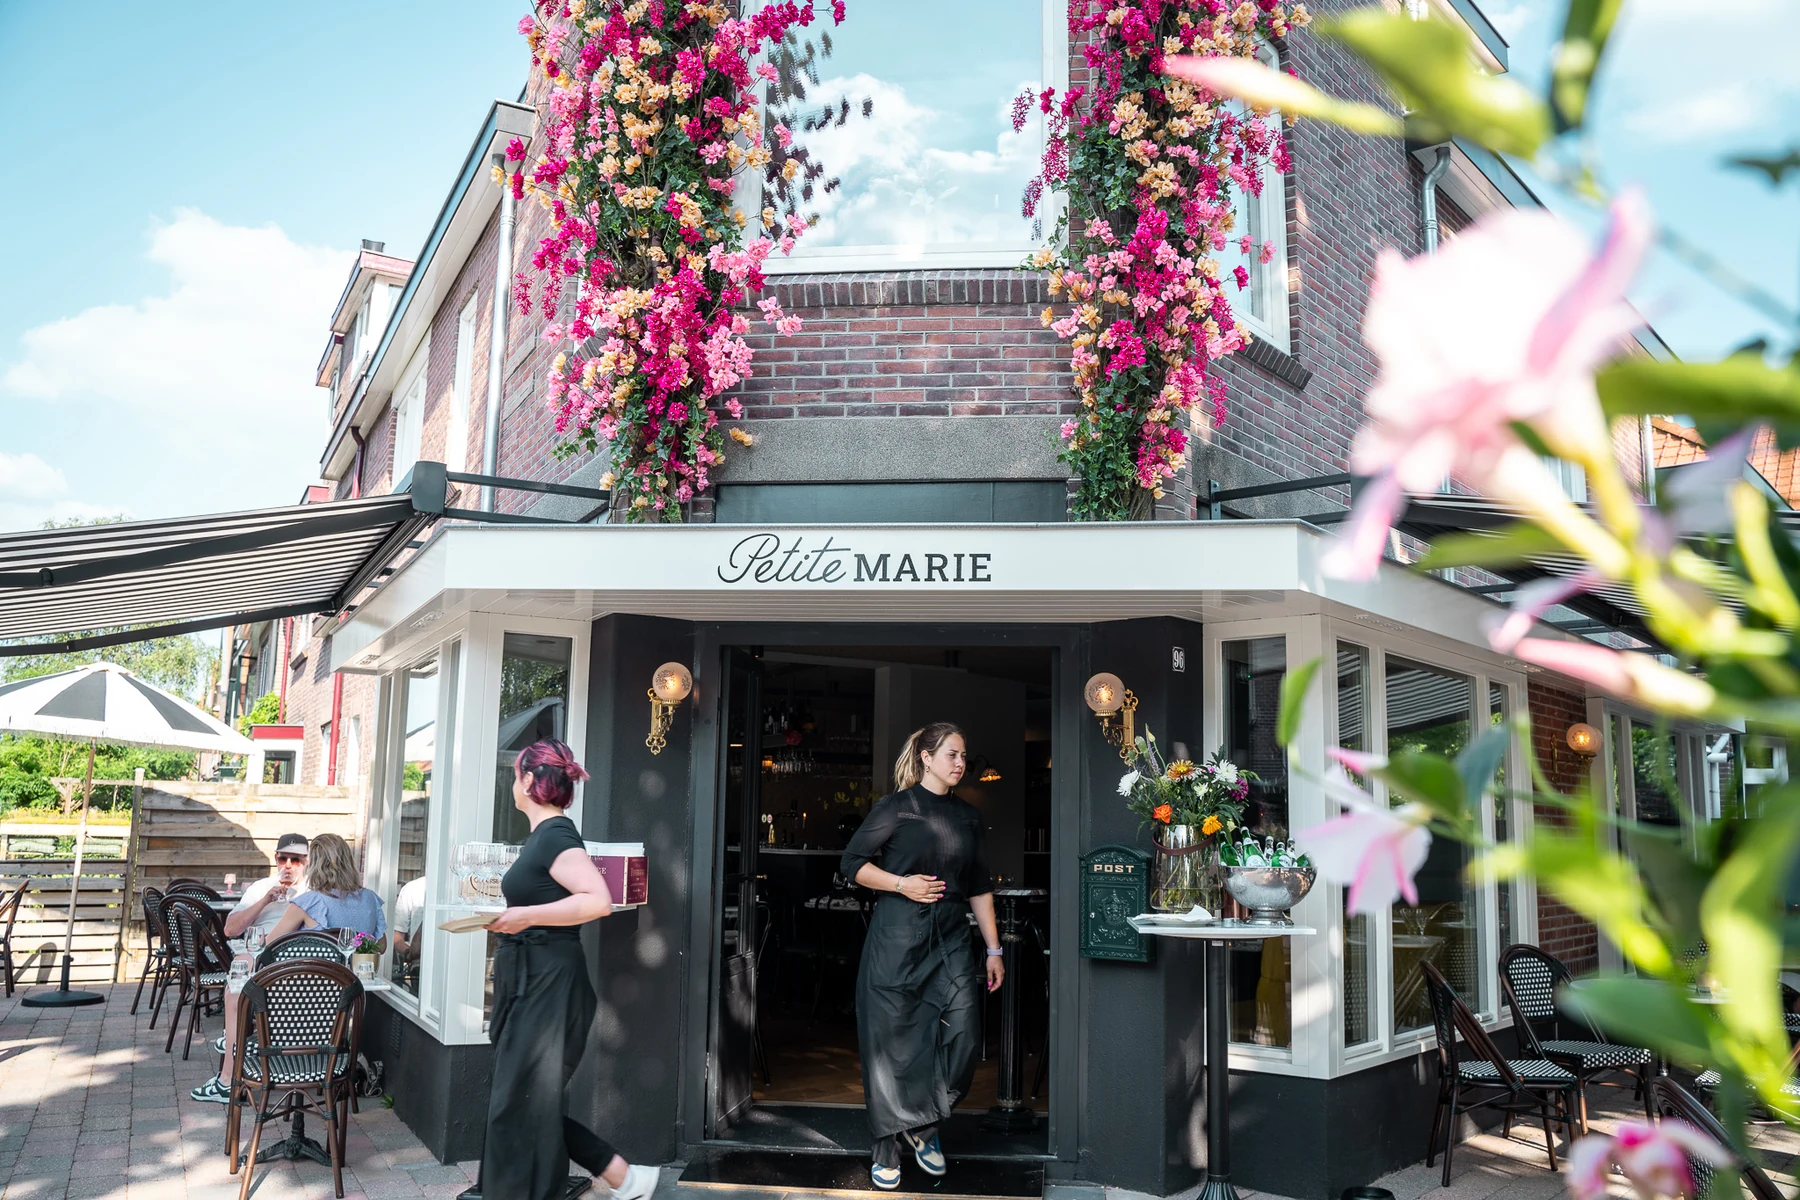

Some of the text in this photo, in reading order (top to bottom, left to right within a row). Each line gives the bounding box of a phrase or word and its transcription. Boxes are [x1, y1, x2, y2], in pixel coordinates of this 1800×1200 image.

[718, 533, 992, 583] Petite MARIE
[1173, 650, 1184, 668] 96
[1093, 864, 1134, 873] POST
